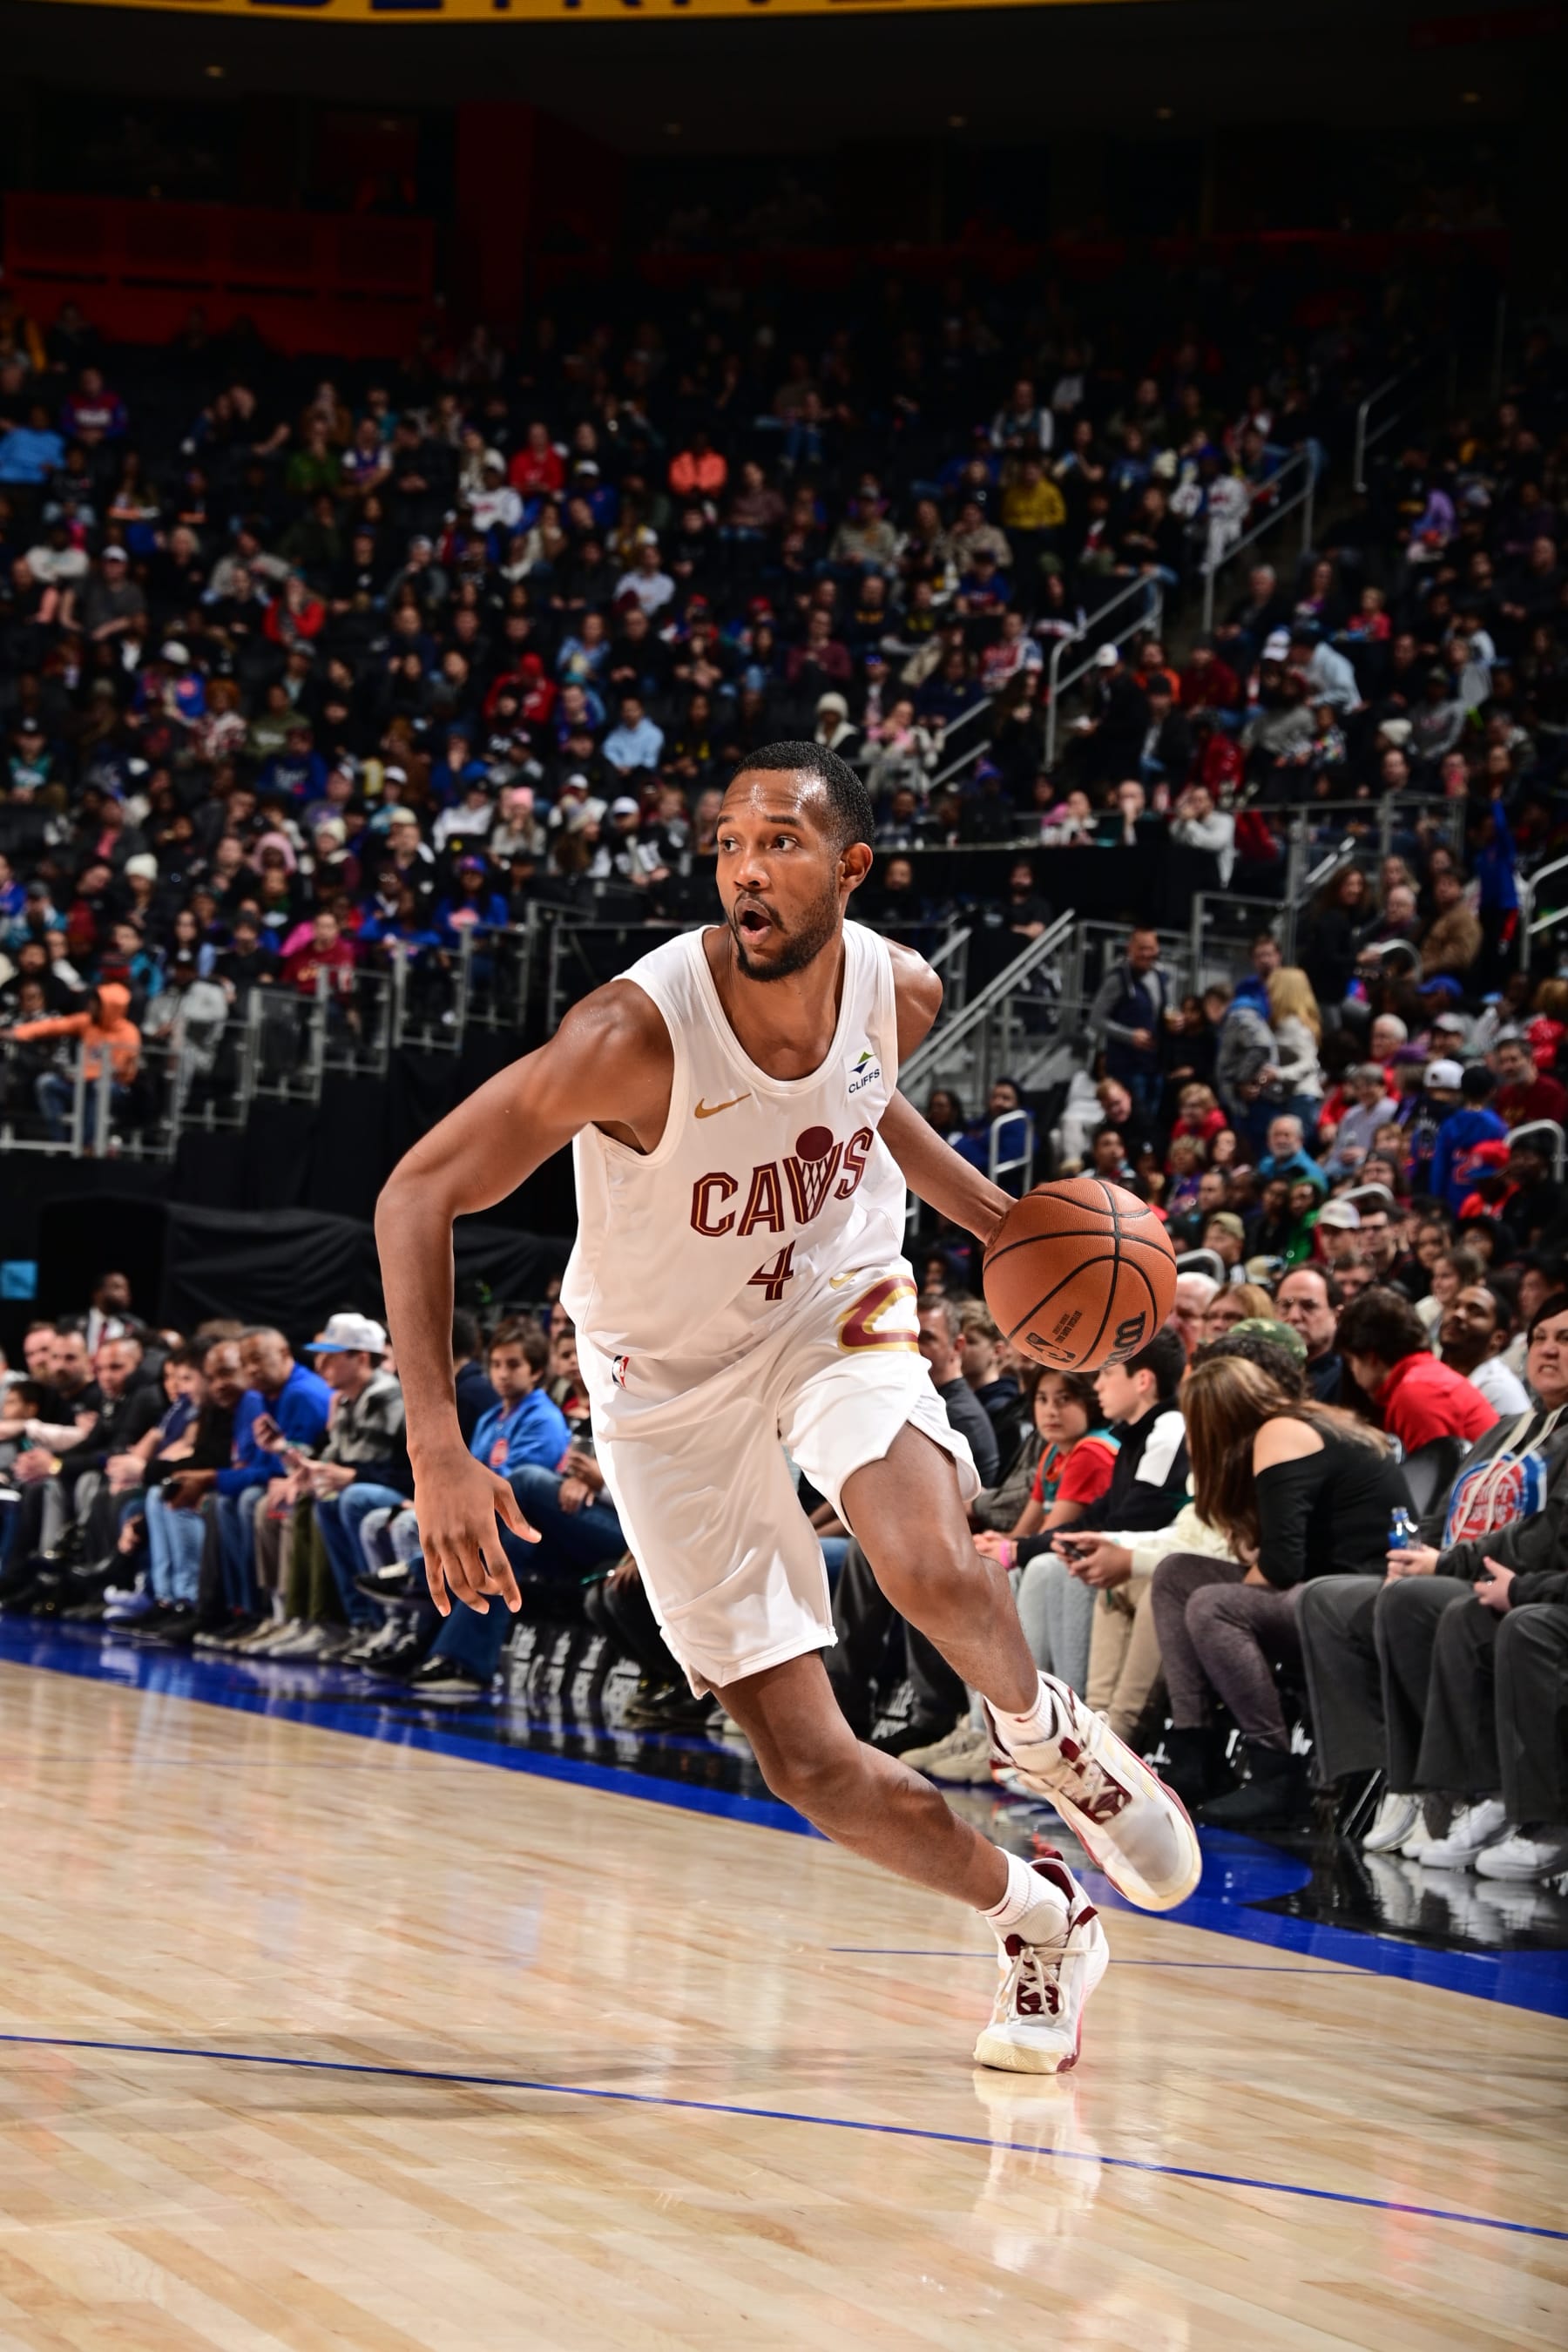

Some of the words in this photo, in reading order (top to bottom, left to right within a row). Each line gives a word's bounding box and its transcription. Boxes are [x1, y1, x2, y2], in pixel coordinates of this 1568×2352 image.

[848, 1068, 881, 1093] CLIFFS
[690, 1125, 874, 1237] CAVS
[746, 1240, 796, 1301] 4
